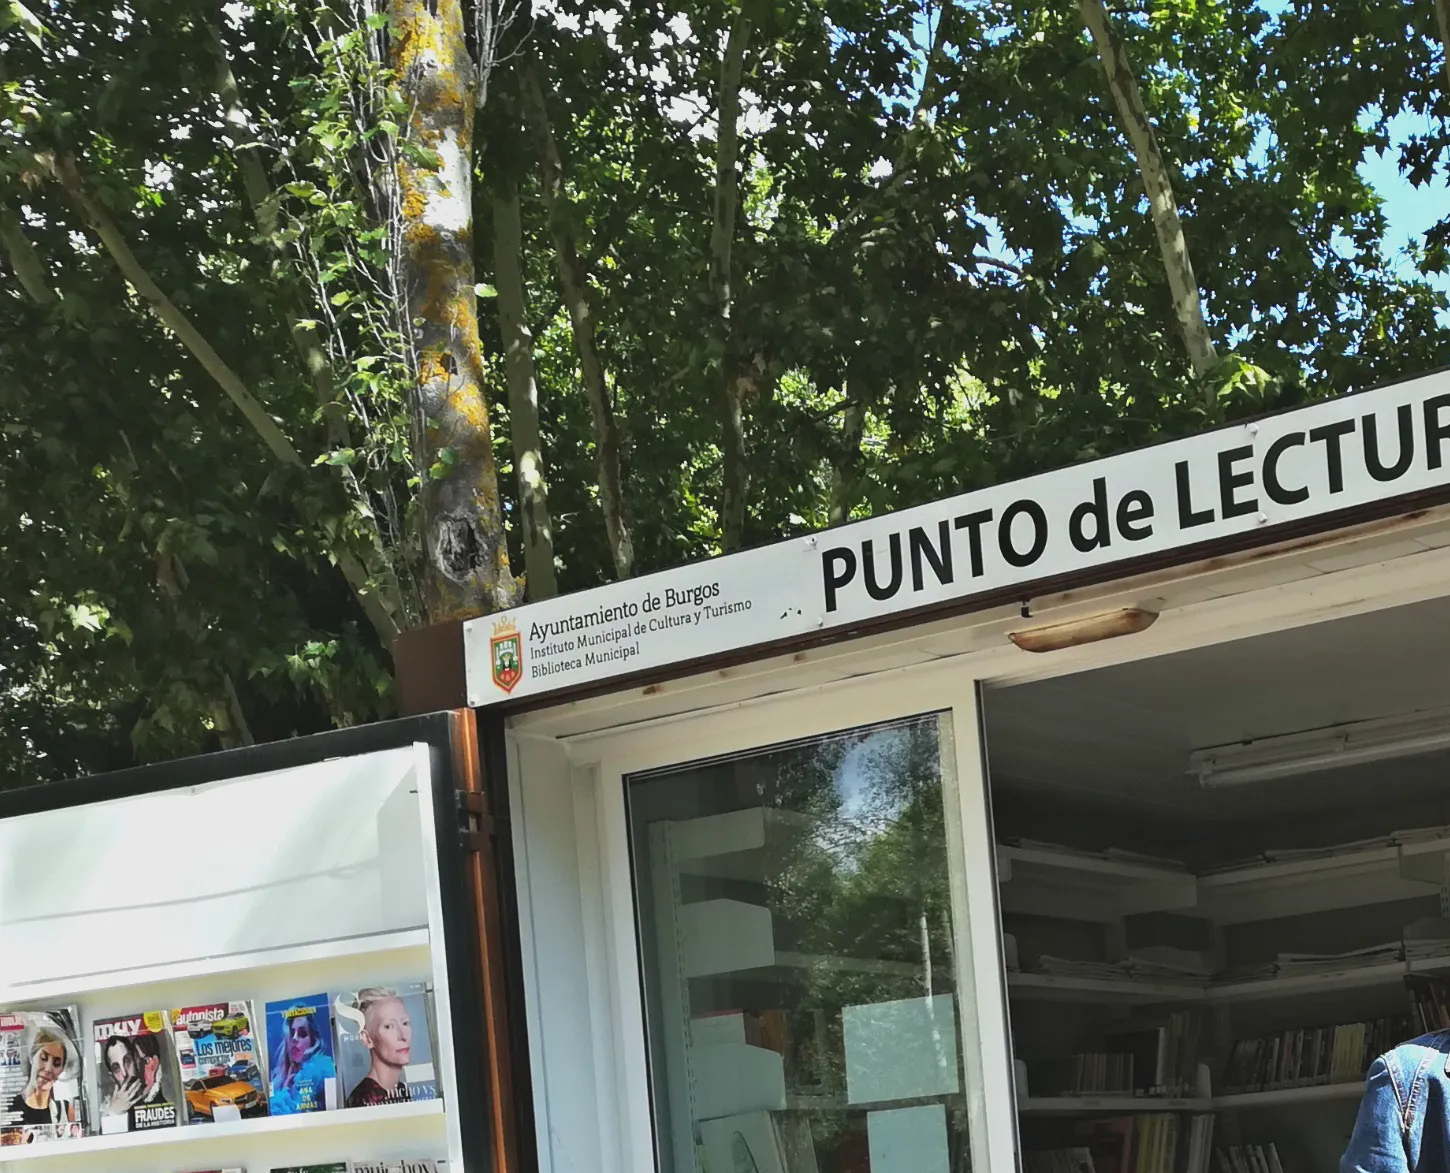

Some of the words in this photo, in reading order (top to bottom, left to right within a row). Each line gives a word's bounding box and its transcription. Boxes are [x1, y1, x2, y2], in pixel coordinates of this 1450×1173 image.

[822, 499, 1049, 612] PUNTO
[1068, 476, 1155, 553] de
[529, 601, 638, 644] Ayuntamiento
[642, 592, 661, 612] de
[665, 582, 720, 605] Burgos
[530, 641, 574, 660] Instituto
[577, 624, 632, 650] Municipal
[634, 621, 647, 636] de
[649, 611, 692, 632] Cultura
[693, 611, 702, 626] y
[703, 599, 752, 619] Turismo
[531, 659, 582, 678] Biblioteca
[585, 642, 640, 667] Municipal
[95, 1019, 141, 1040] muy
[194, 1040, 214, 1057] Los
[215, 1037, 252, 1058] mejores
[135, 1106, 175, 1123] FRAUDES
